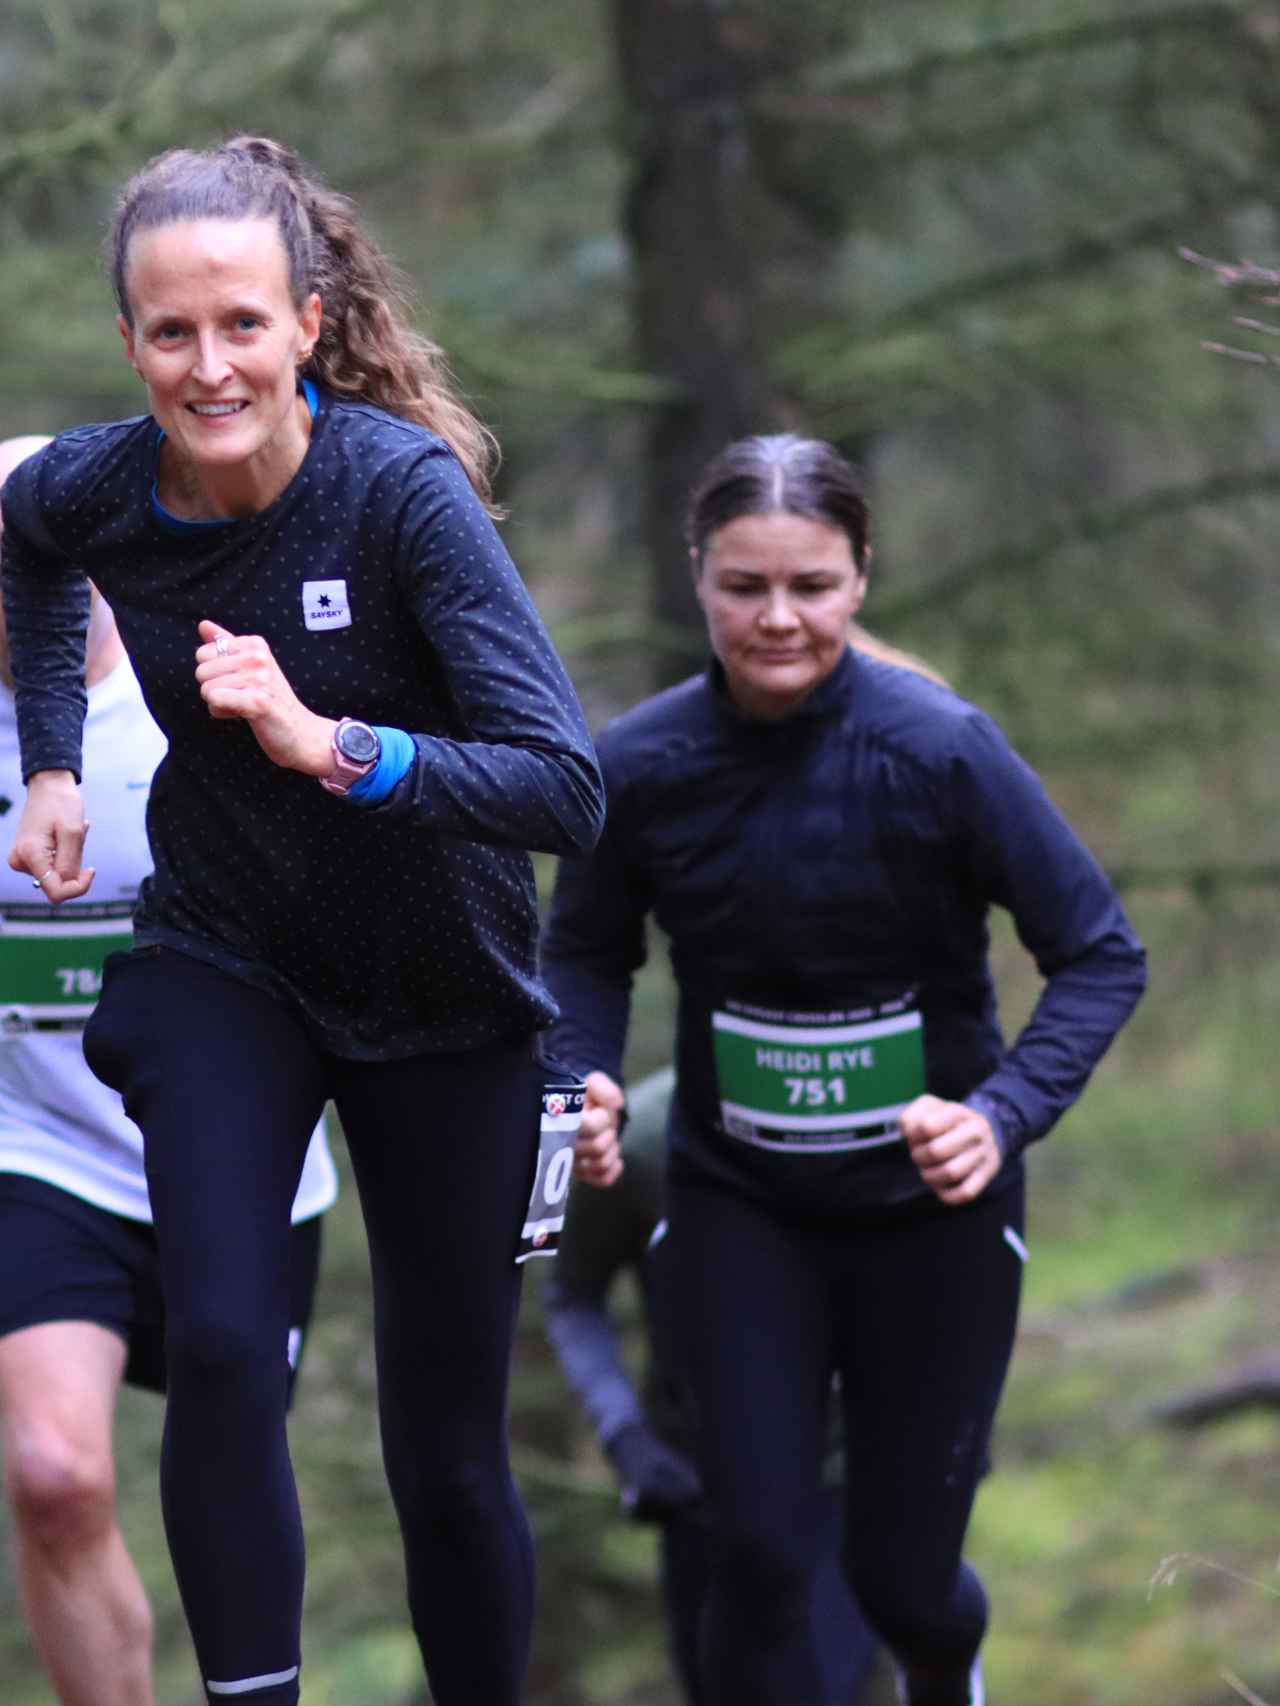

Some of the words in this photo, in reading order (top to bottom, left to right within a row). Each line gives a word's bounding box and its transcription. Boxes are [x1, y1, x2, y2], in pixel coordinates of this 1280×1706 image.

[310, 609, 344, 619] SAYSKY
[756, 1047, 821, 1072] HEIDI
[828, 1046, 875, 1070] RYE
[783, 1077, 846, 1106] 751
